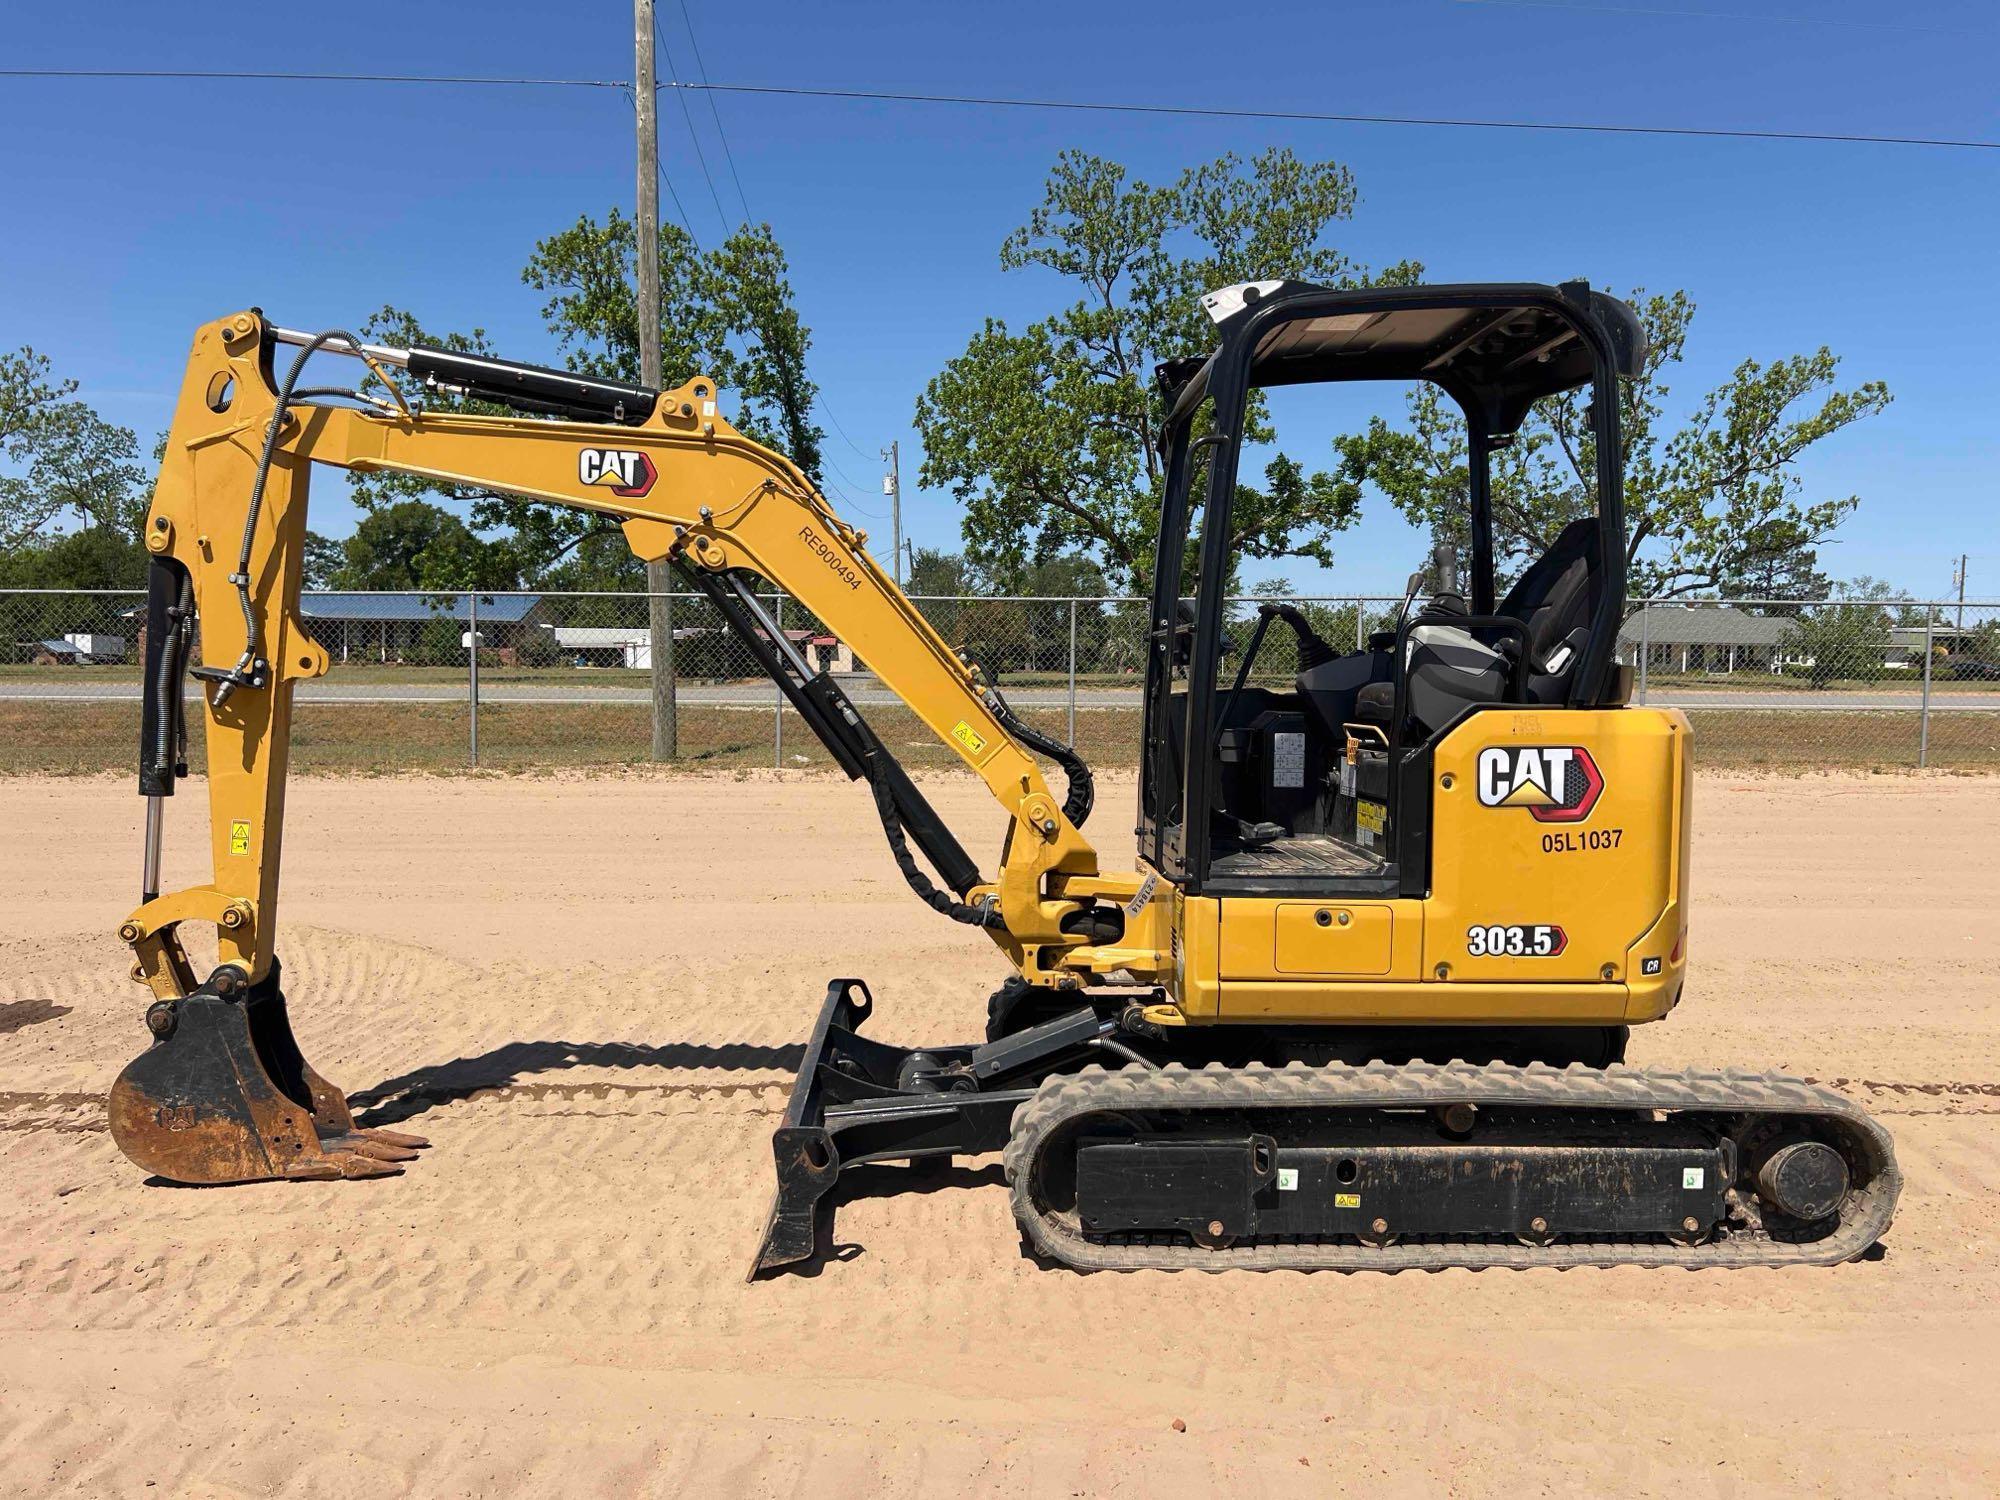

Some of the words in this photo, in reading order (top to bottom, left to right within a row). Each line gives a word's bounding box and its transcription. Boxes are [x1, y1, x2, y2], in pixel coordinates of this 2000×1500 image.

[581, 449, 639, 487] CAT
[798, 526, 862, 591] RE900494
[1480, 748, 1573, 805] CAT
[1542, 829, 1623, 853] 05L1037
[1468, 926, 1552, 955] 303.5
[1647, 960, 1659, 972] CR
